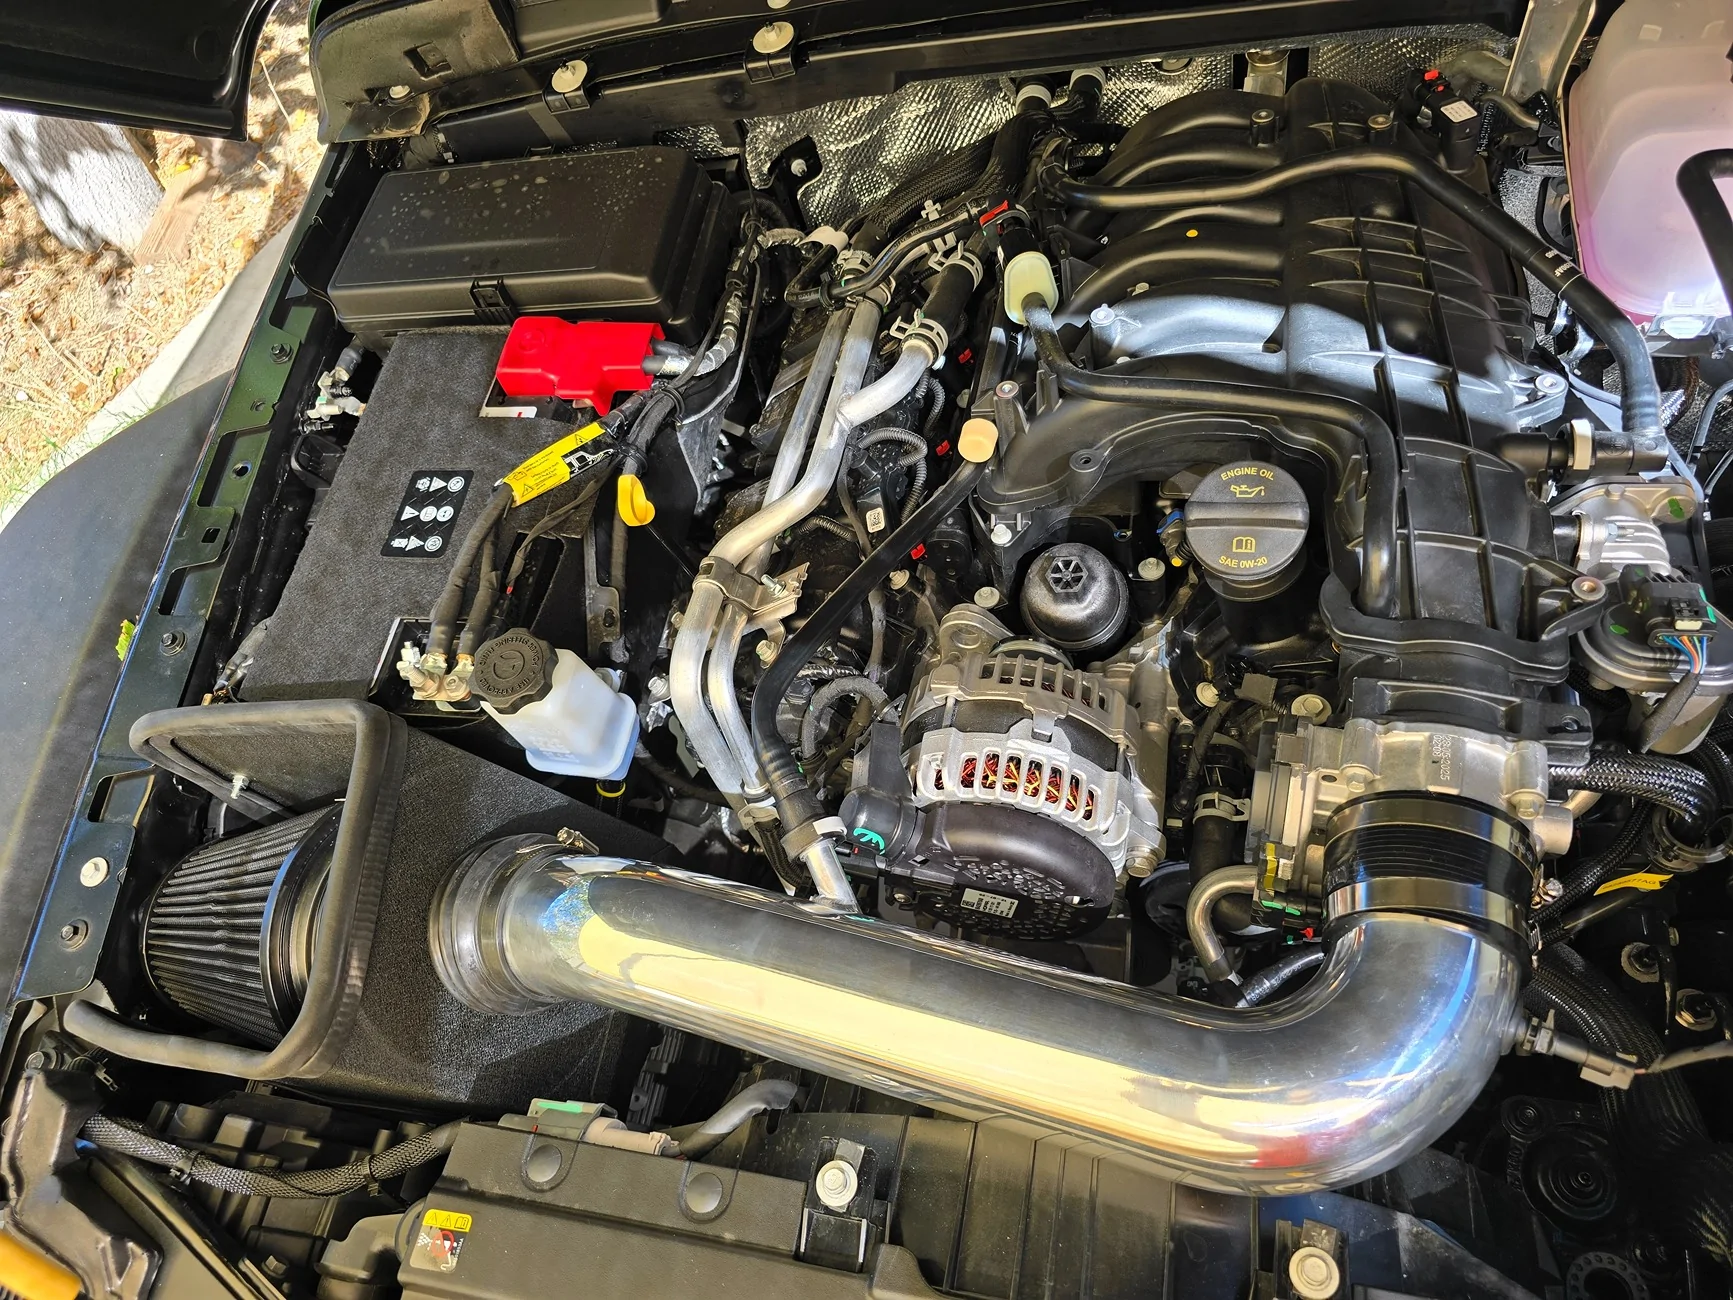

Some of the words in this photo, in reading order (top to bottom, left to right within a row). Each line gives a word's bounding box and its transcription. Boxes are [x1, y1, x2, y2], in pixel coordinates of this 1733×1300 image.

[1221, 467, 1258, 481] ENGINE
[1259, 467, 1274, 481] OIL
[1219, 555, 1238, 568] SAE
[1240, 556, 1267, 568] 0W-20
